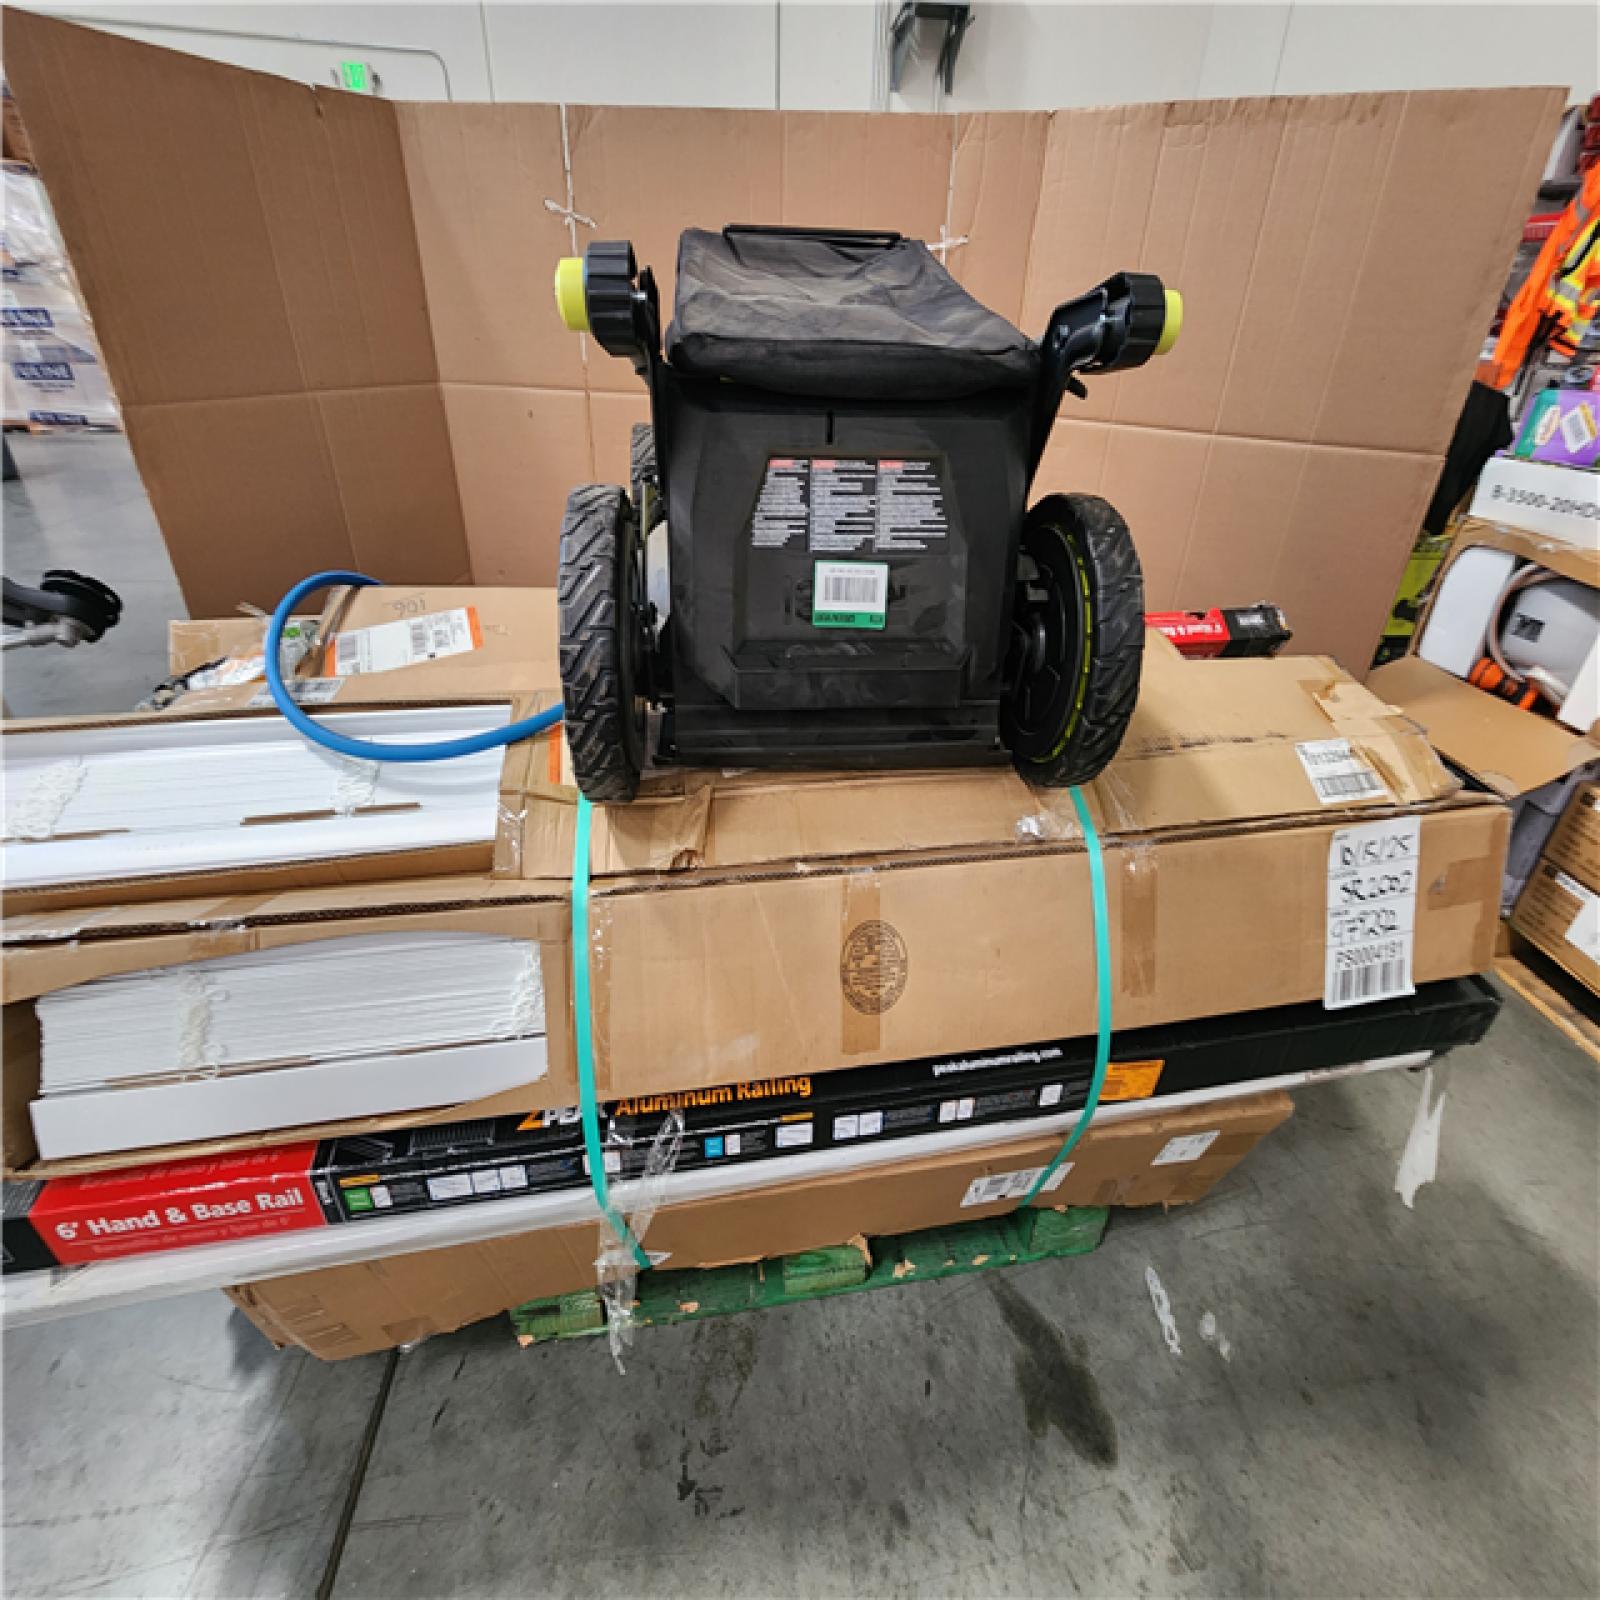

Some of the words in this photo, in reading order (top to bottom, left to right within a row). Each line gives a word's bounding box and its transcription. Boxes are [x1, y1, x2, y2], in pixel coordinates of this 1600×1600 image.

[614, 1086, 733, 1117] Aluminum
[737, 1075, 812, 1101] Railing
[55, 1221, 79, 1241] 6'
[86, 1210, 160, 1235] Hand
[165, 1206, 188, 1224] &
[190, 1199, 252, 1221] Base
[255, 1186, 304, 1211] Rail
